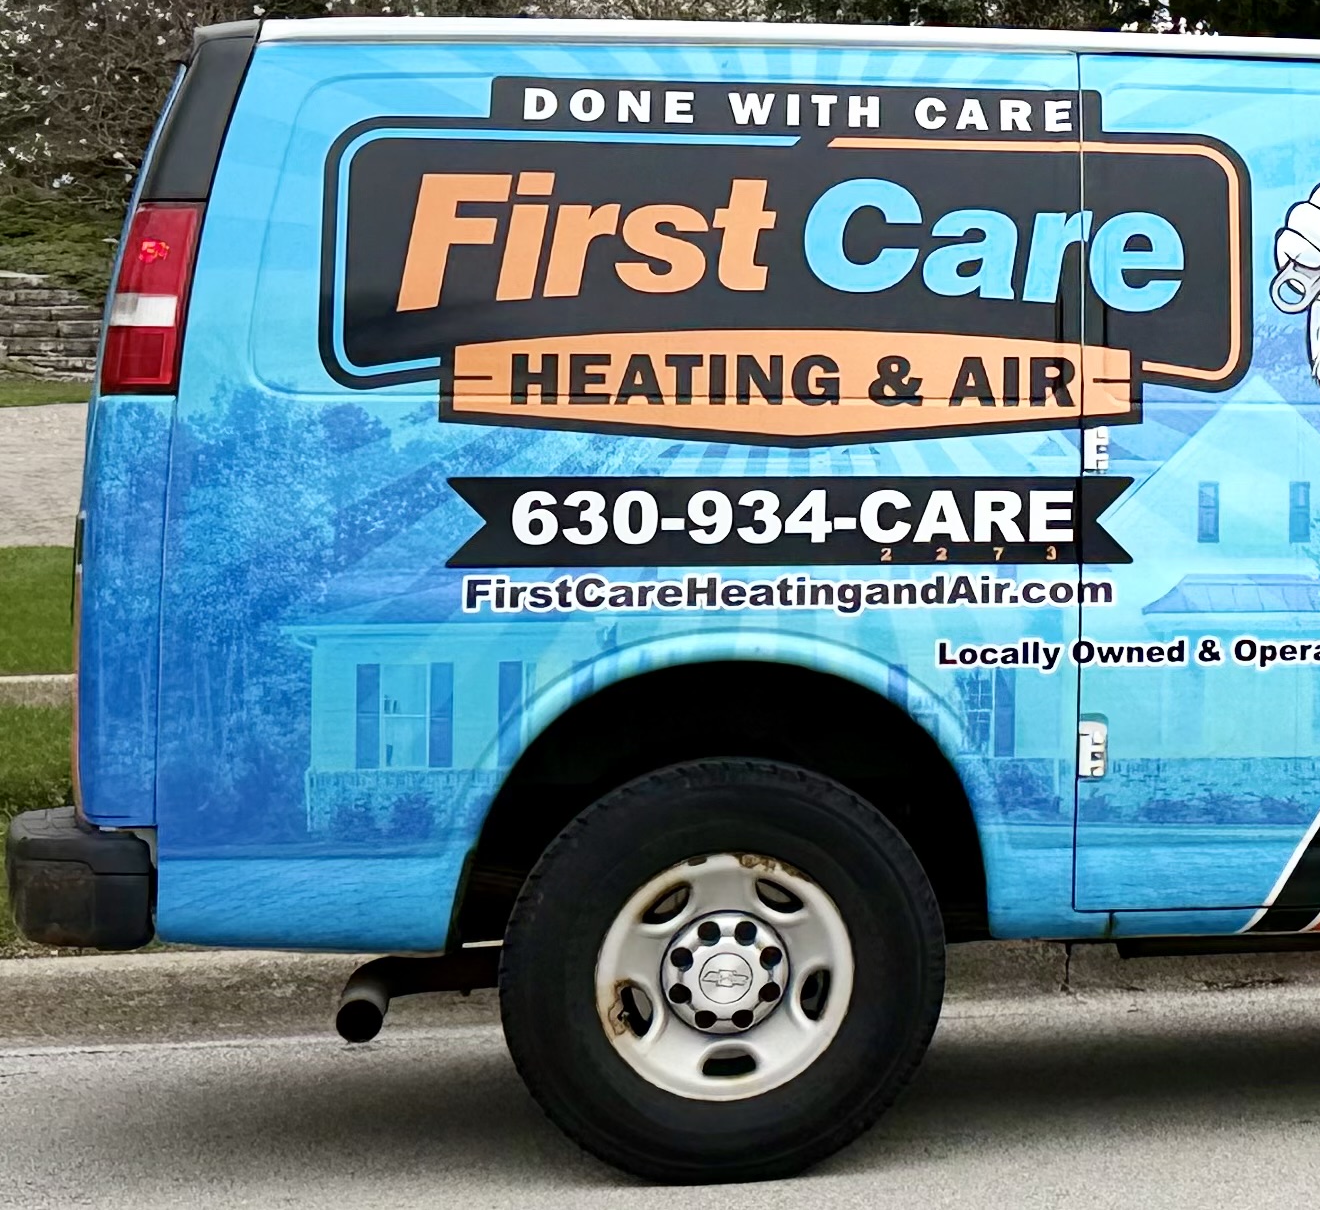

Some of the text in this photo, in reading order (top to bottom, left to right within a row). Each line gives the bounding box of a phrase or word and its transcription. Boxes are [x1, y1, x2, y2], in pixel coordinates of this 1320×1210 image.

[523, 88, 1074, 133] DONE WITH CARE
[396, 171, 1185, 313] First Care
[511, 353, 1076, 408] HEATING & AIR
[510, 489, 1074, 547] 630-934-CARE
[465, 576, 1114, 613] FirstCareHeatingandAir.com
[938, 640, 1060, 670] Locally
[1072, 639, 1185, 666] Owned
[1198, 638, 1221, 662] &
